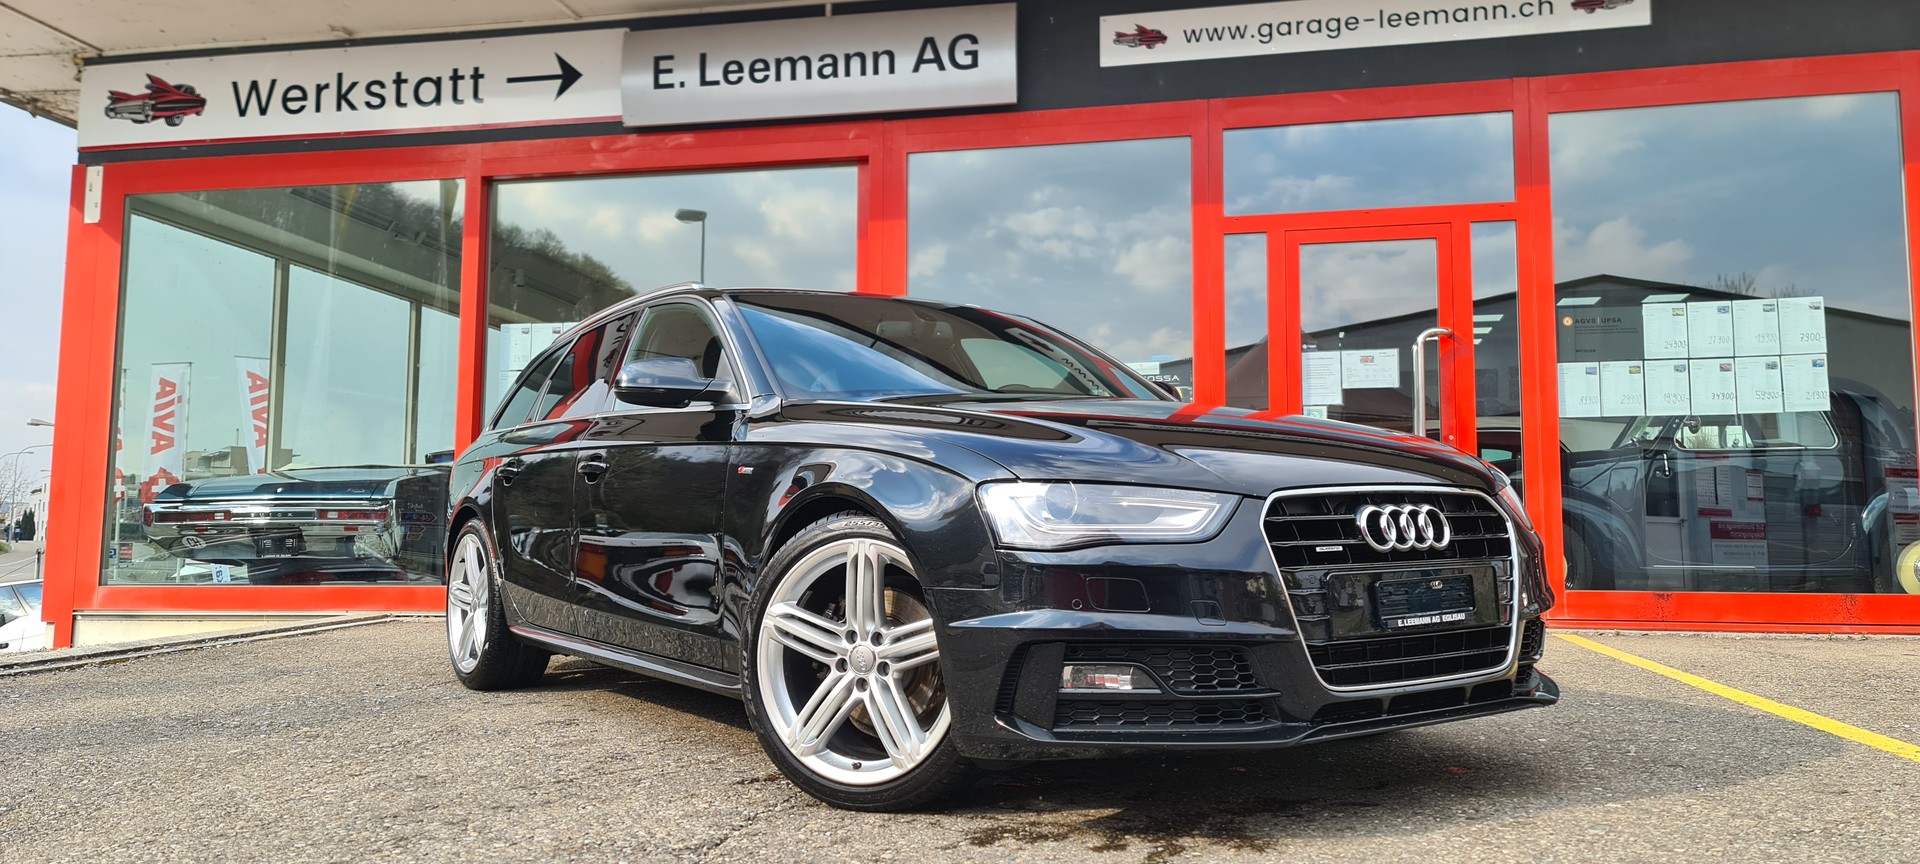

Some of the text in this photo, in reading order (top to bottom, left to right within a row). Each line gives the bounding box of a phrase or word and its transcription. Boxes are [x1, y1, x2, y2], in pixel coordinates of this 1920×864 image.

[1182, 0, 1554, 45] www.garage-leemann.ch
[652, 33, 980, 90] E. Leemann AG
[232, 66, 486, 118] Werkstatt
[1404, 616, 1432, 627] LEEMANN
[1432, 615, 1441, 623] AG
